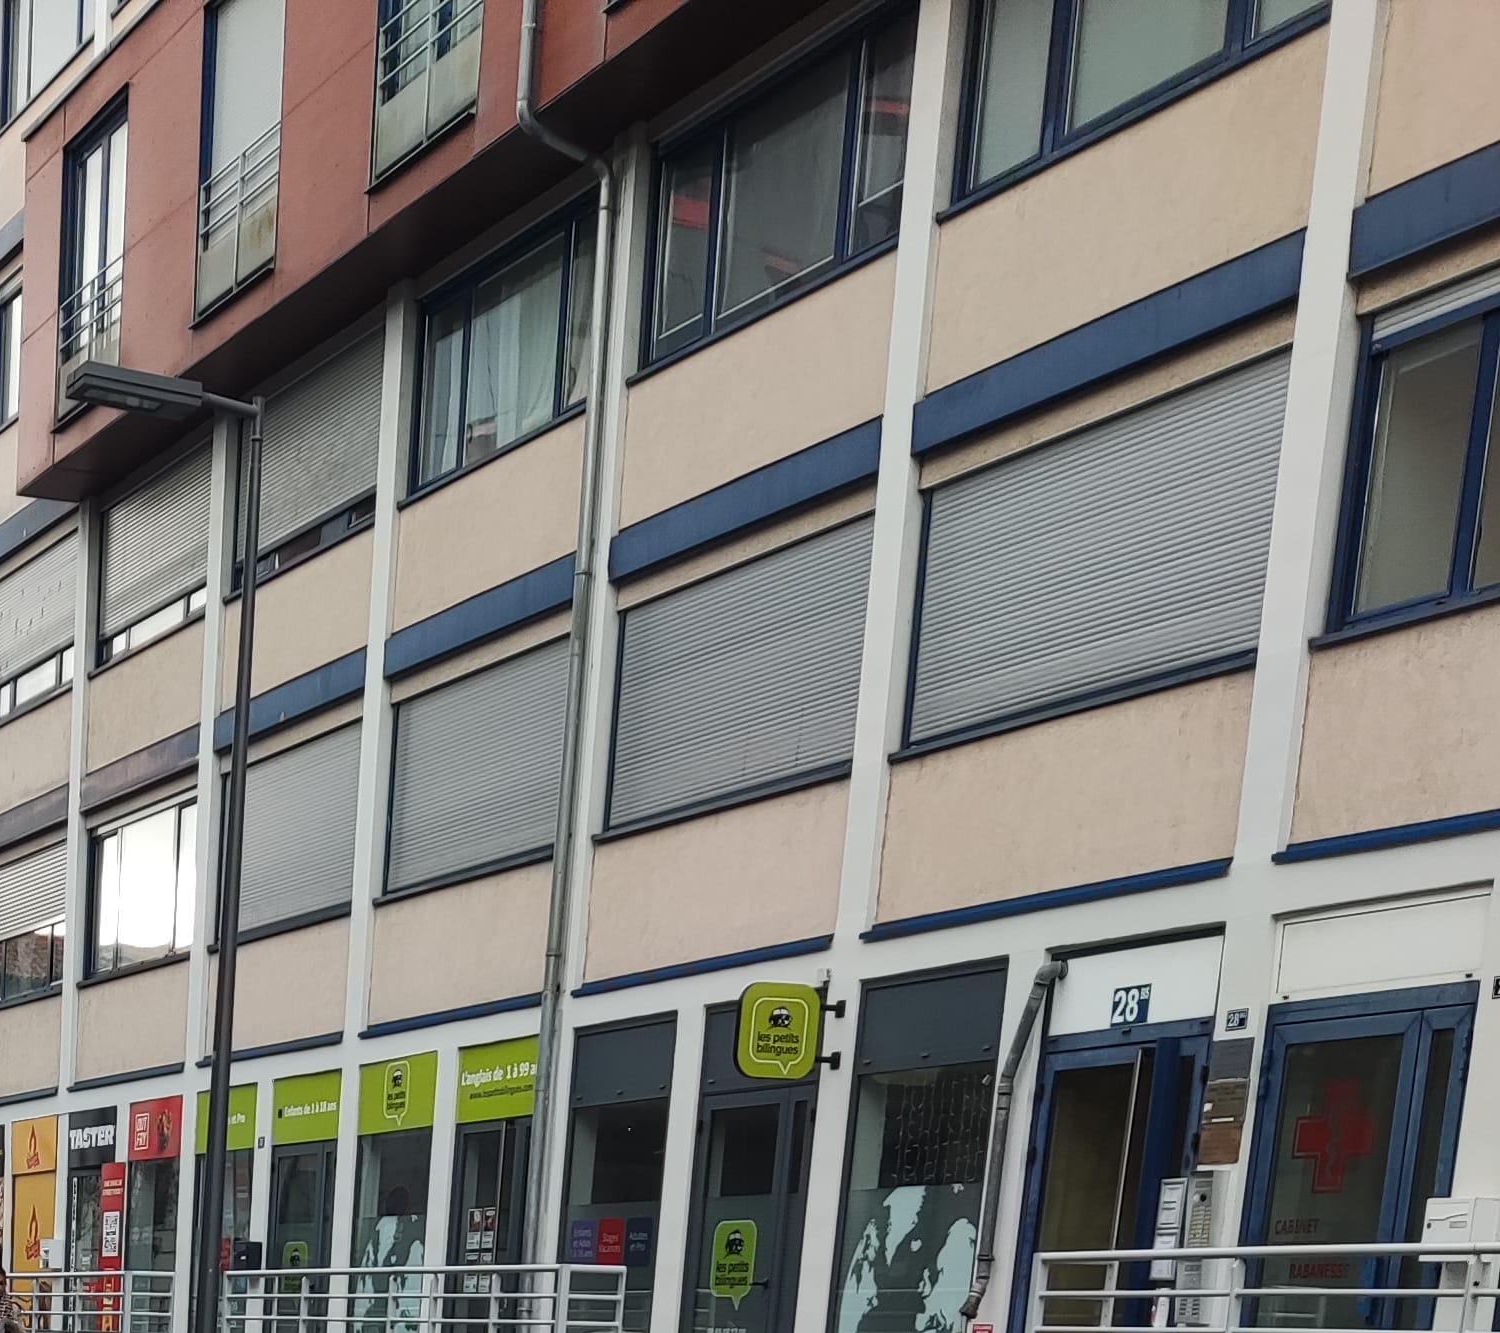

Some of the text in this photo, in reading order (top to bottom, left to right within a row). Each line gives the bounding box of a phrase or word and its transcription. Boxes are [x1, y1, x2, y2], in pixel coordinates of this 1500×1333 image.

[1111, 988, 1139, 1024] 28
[1228, 1012, 1240, 1027] 28
[757, 1031, 799, 1044] les petits
[756, 1043, 798, 1056] bilingues
[493, 1066, 503, 1082] de
[519, 1062, 529, 1077] 99
[70, 1124, 114, 1150] TASTER
[1275, 1218, 1320, 1235] CABINET
[716, 1261, 749, 1274] les petits
[715, 1274, 748, 1289] bilingues
